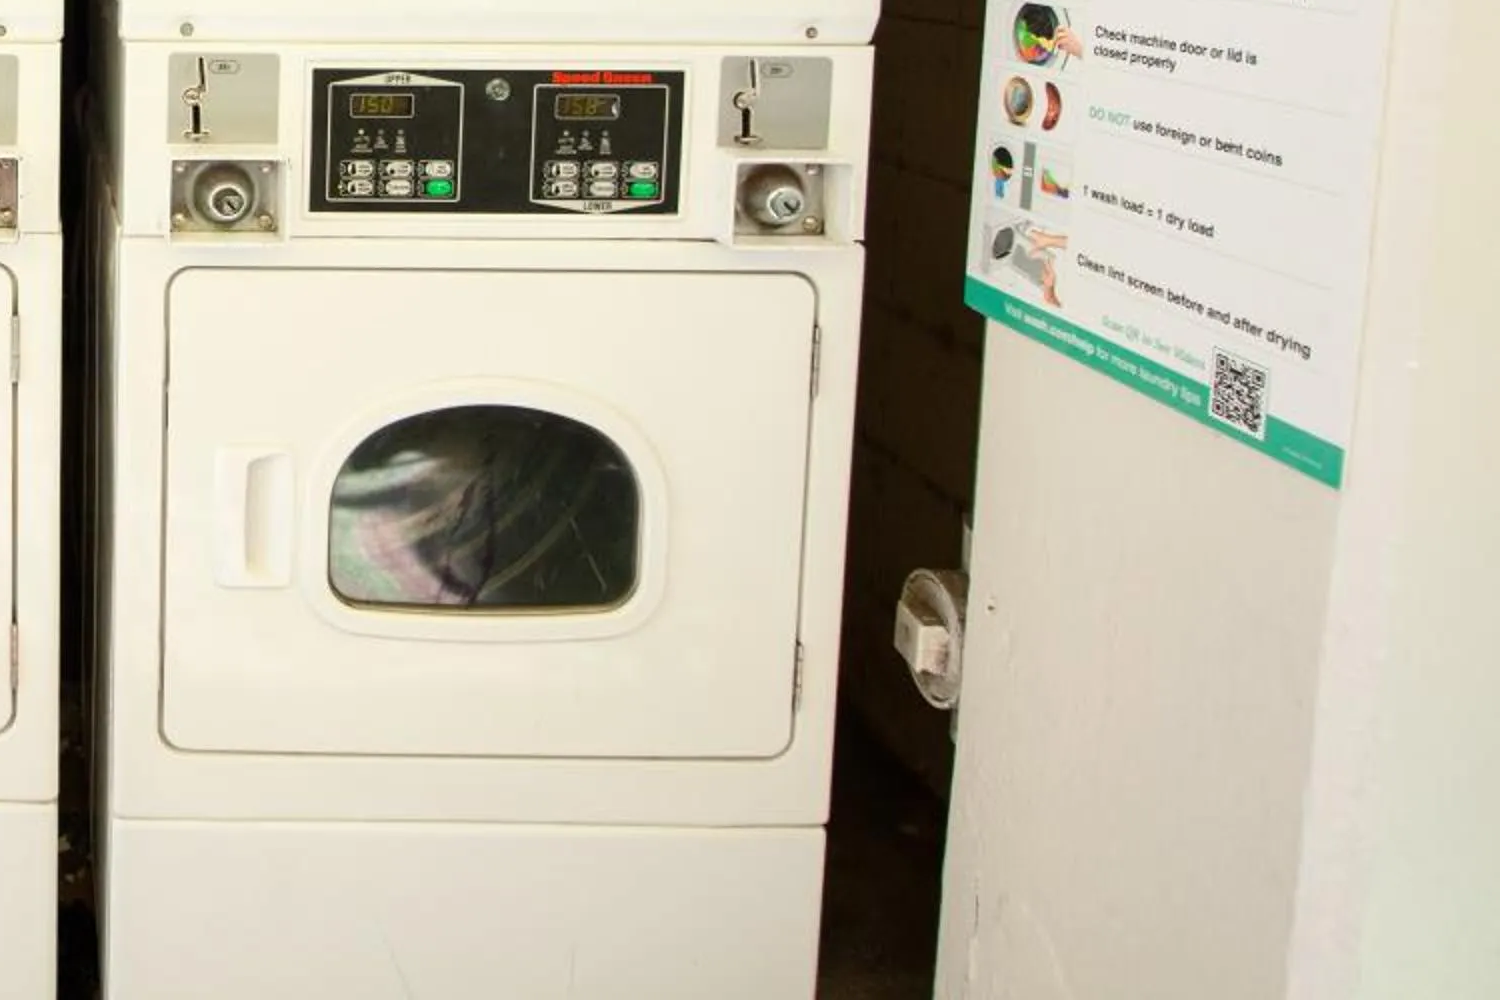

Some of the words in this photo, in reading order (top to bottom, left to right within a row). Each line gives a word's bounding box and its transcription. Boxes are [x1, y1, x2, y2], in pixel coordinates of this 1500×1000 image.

[1094, 45, 1127, 61] closed
[1130, 52, 1176, 72] properly
[1095, 25, 1127, 44] Check
[1130, 33, 1177, 51] machine
[1180, 40, 1208, 56] door
[1210, 46, 1224, 59] or
[1227, 47, 1243, 63] lid
[1245, 53, 1258, 66] is
[552, 71, 600, 84] Speed
[603, 71, 653, 83] Queen
[1133, 118, 1153, 133] use
[1156, 122, 1196, 145] foreign
[1200, 134, 1213, 148] or
[1215, 138, 1243, 157] bent
[1246, 146, 1283, 167] coins
[1091, 187, 1118, 206] wash
[1121, 196, 1144, 216] load
[1165, 211, 1185, 231] dry
[1188, 218, 1214, 238] load
[1077, 252, 1105, 274] Clean
[1108, 264, 1125, 282] lint
[1128, 272, 1164, 298] screen
[1168, 286, 1204, 316] before
[1207, 304, 1231, 325] and
[1234, 312, 1262, 338] after
[1266, 327, 1312, 360] drying
